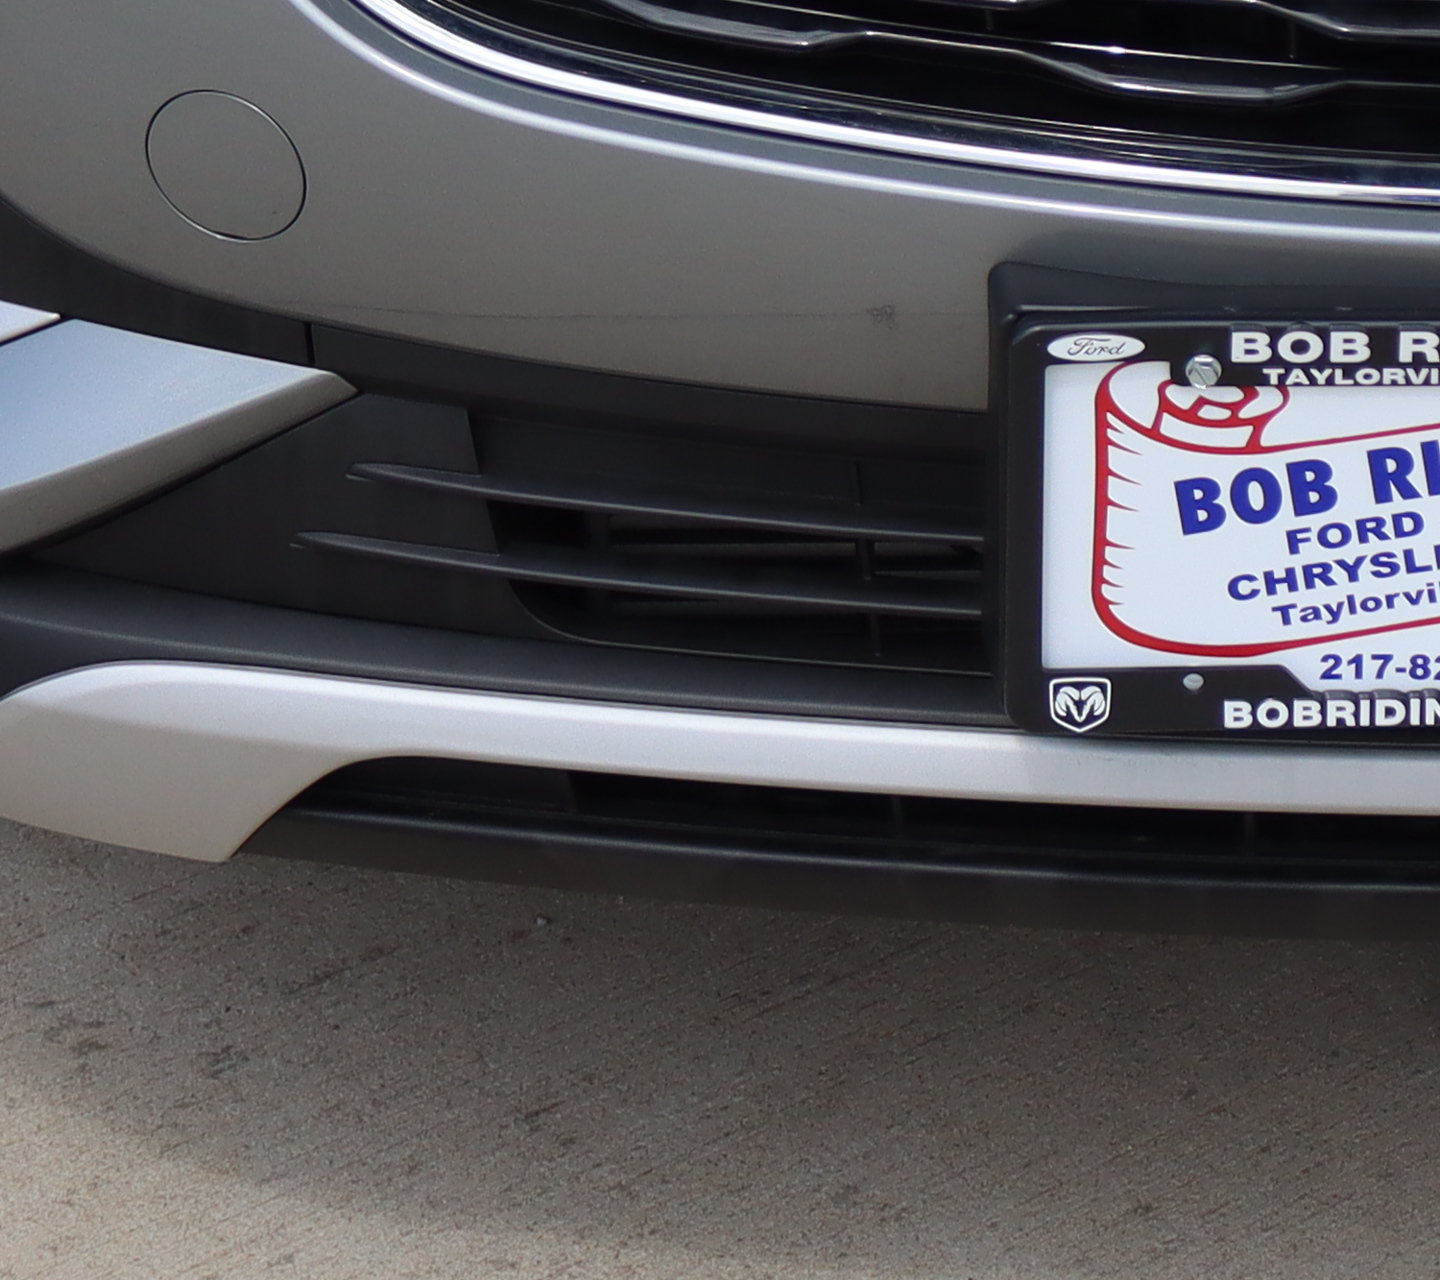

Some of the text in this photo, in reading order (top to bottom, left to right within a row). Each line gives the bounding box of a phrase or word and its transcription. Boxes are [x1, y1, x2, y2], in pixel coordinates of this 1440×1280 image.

[1066, 337, 1129, 357] Ford
[1230, 330, 1371, 364] BOB
[1173, 458, 1339, 536] BOB
[1285, 510, 1425, 555] FORD
